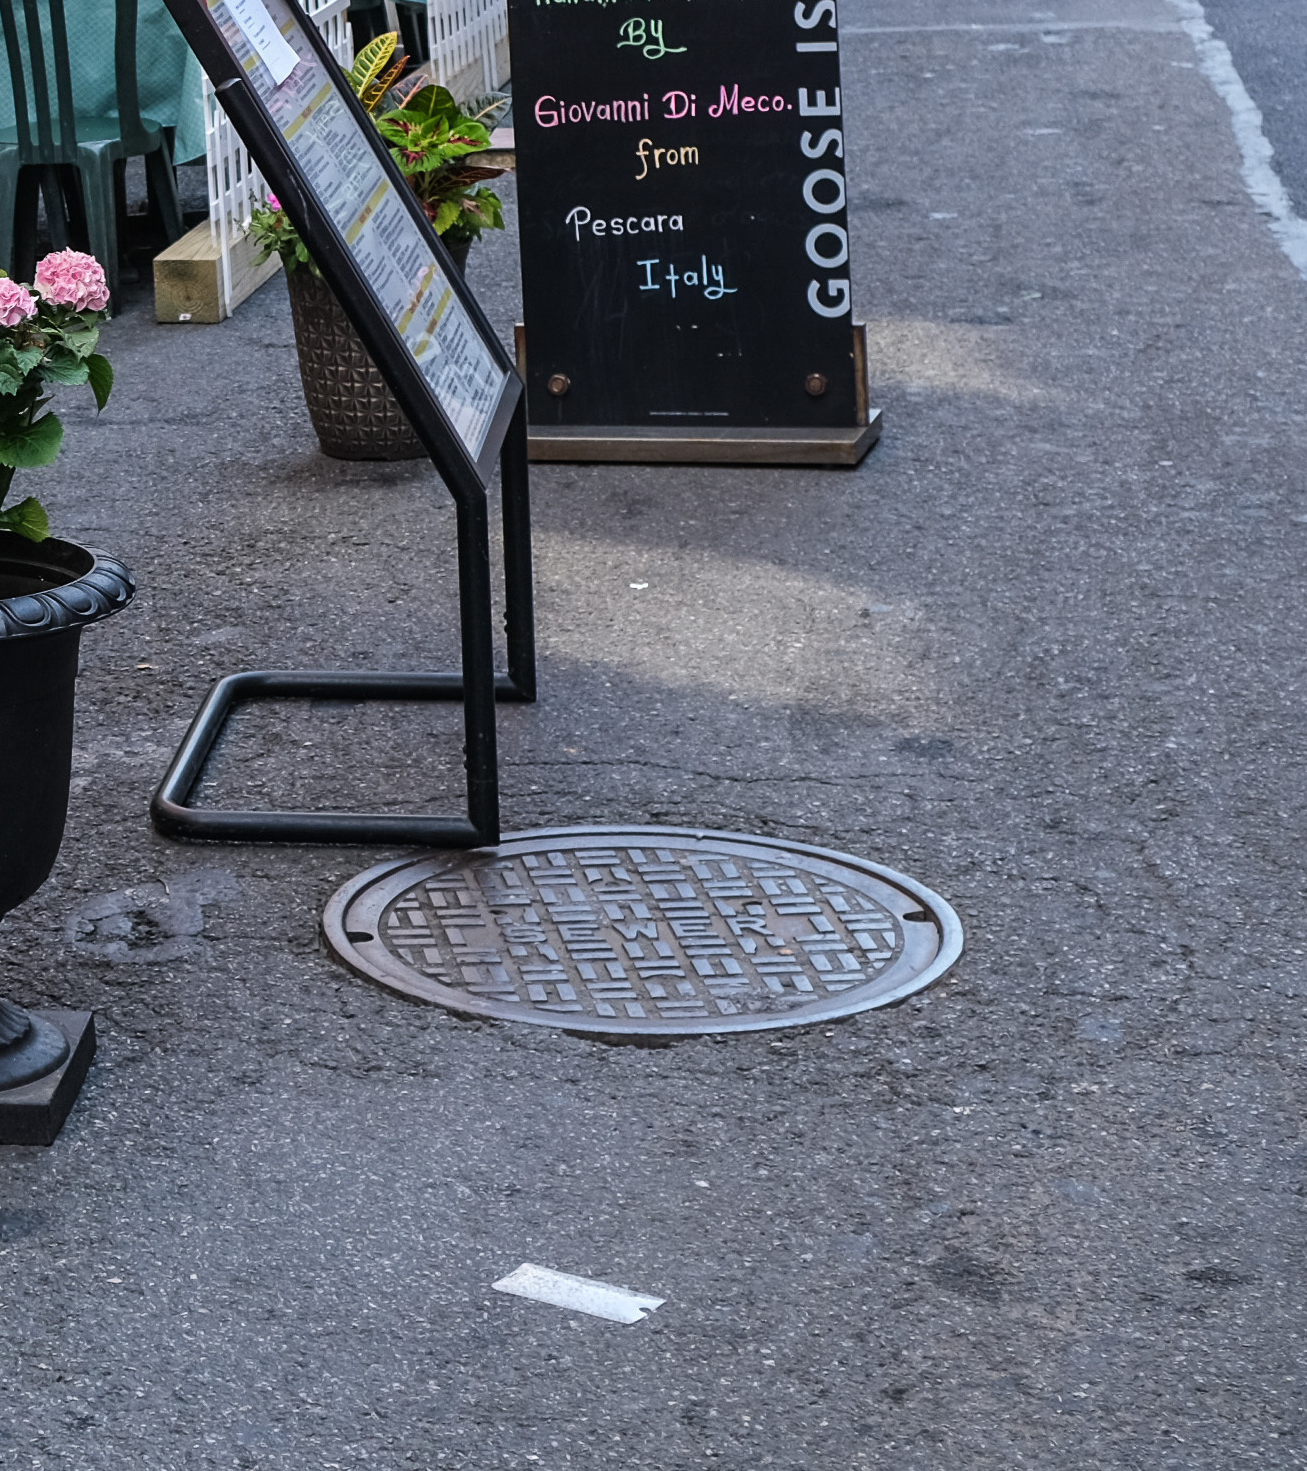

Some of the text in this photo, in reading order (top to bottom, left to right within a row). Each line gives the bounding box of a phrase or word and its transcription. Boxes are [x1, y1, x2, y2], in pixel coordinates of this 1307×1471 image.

[534, 92, 650, 128] Giovanni
[661, 90, 697, 120] Di
[634, 138, 699, 181] from
[797, 85, 851, 318] GOOSE
[565, 206, 684, 242] Pescara
[636, 254, 738, 300] Italy
[502, 917, 773, 945] SEWER
